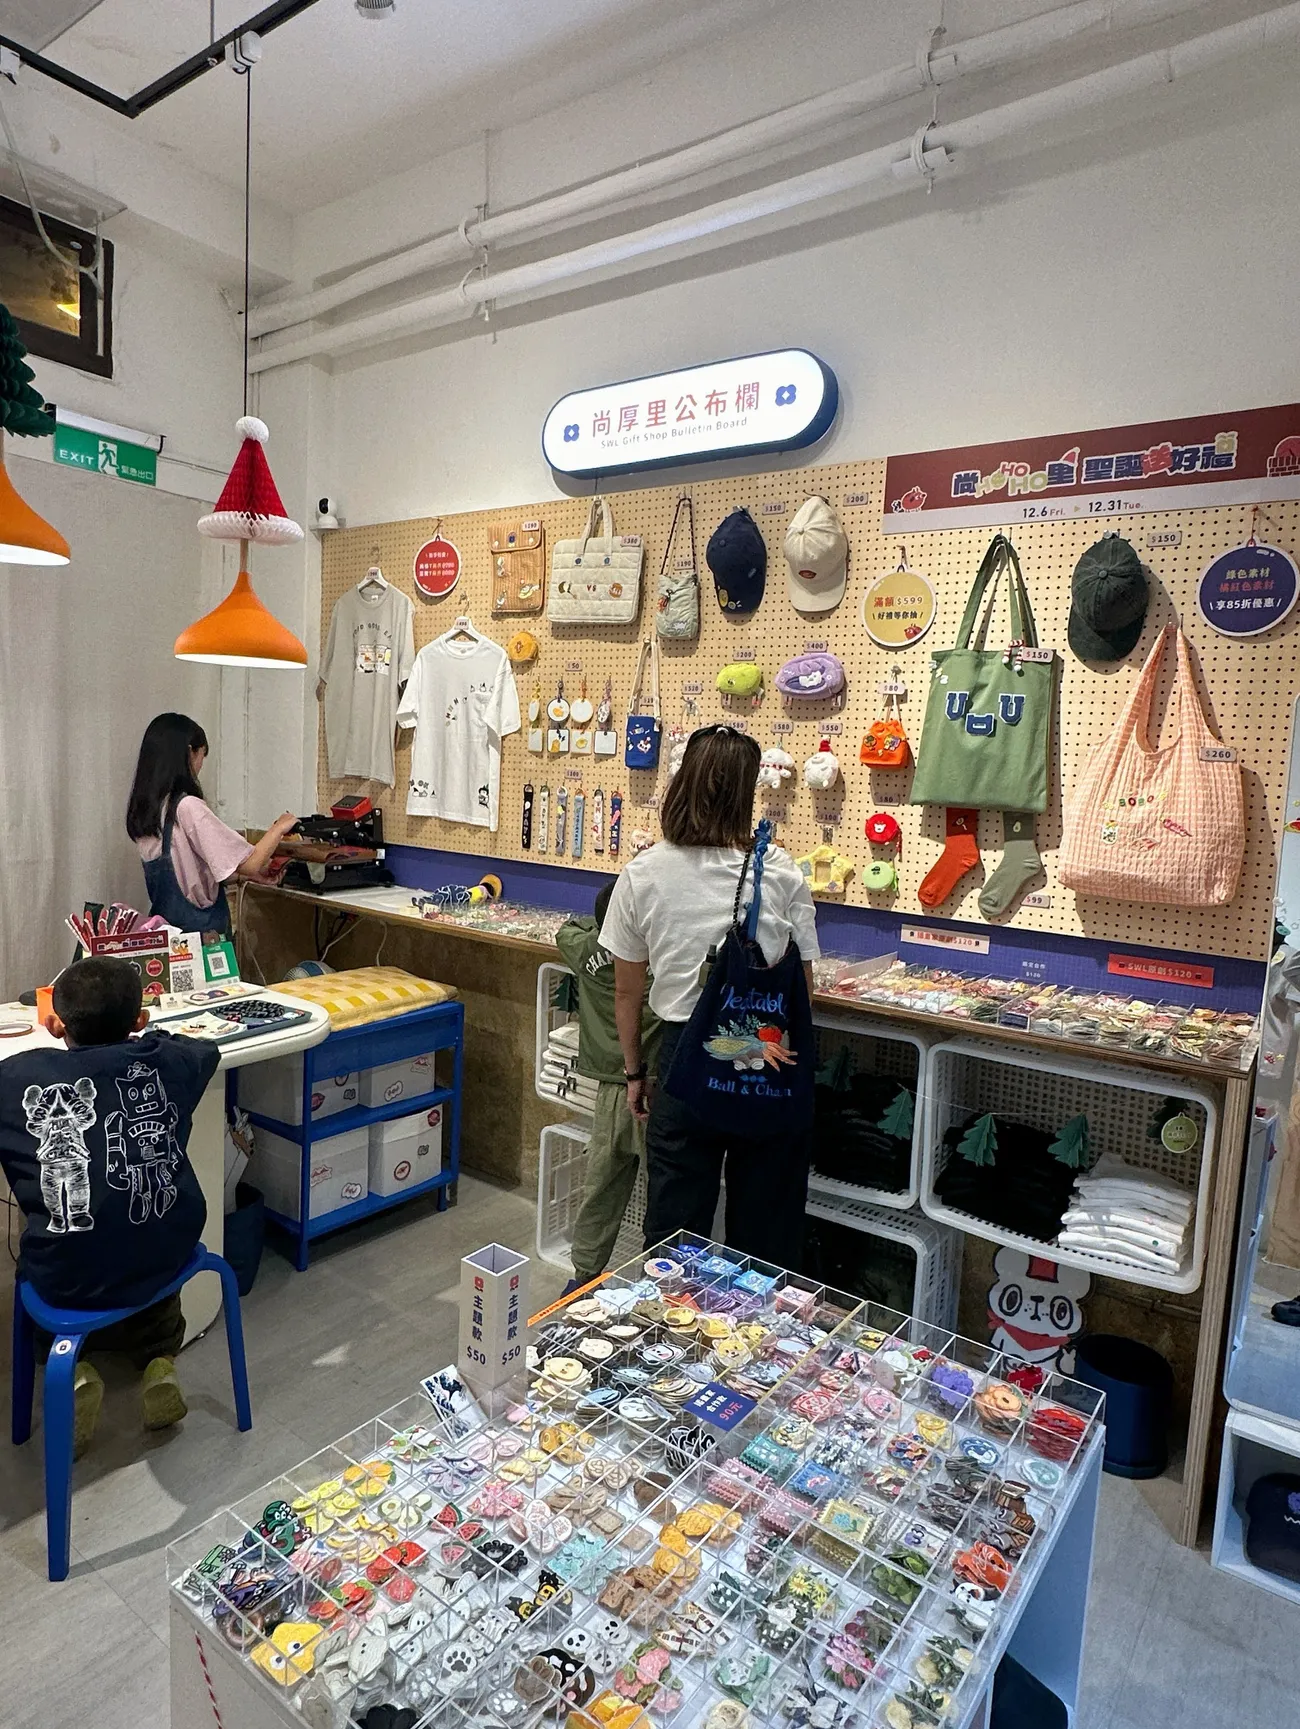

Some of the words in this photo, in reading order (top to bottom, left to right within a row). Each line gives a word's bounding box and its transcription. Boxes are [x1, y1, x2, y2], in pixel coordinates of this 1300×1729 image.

[592, 381, 760, 438] 尚厚里公布欄
[601, 440, 619, 449] SWL
[623, 435, 640, 446] Gift
[644, 431, 668, 443] Shop
[671, 422, 712, 438] Bulletin
[716, 416, 748, 431] Board
[59, 449, 94, 466] EXIT
[121, 465, 154, 480] 緊急出口
[1022, 507, 1048, 518] 12.6
[1088, 500, 1122, 513] 12.31
[1151, 534, 1176, 544] $150
[1215, 598, 1274, 610] 享85折優惠
[1025, 650, 1049, 659] $150
[884, 684, 899, 692] $80
[1205, 749, 1231, 759] $260
[1026, 896, 1043, 904] $99
[741, 1085, 749, 1095] &
[755, 1083, 792, 1097] Chan
[472, 1295, 484, 1342] 主題款
[507, 1295, 518, 1341] 主題款
[467, 1346, 486, 1365] $50
[502, 1345, 521, 1365] $50
[719, 1402, 743, 1420] 90元
